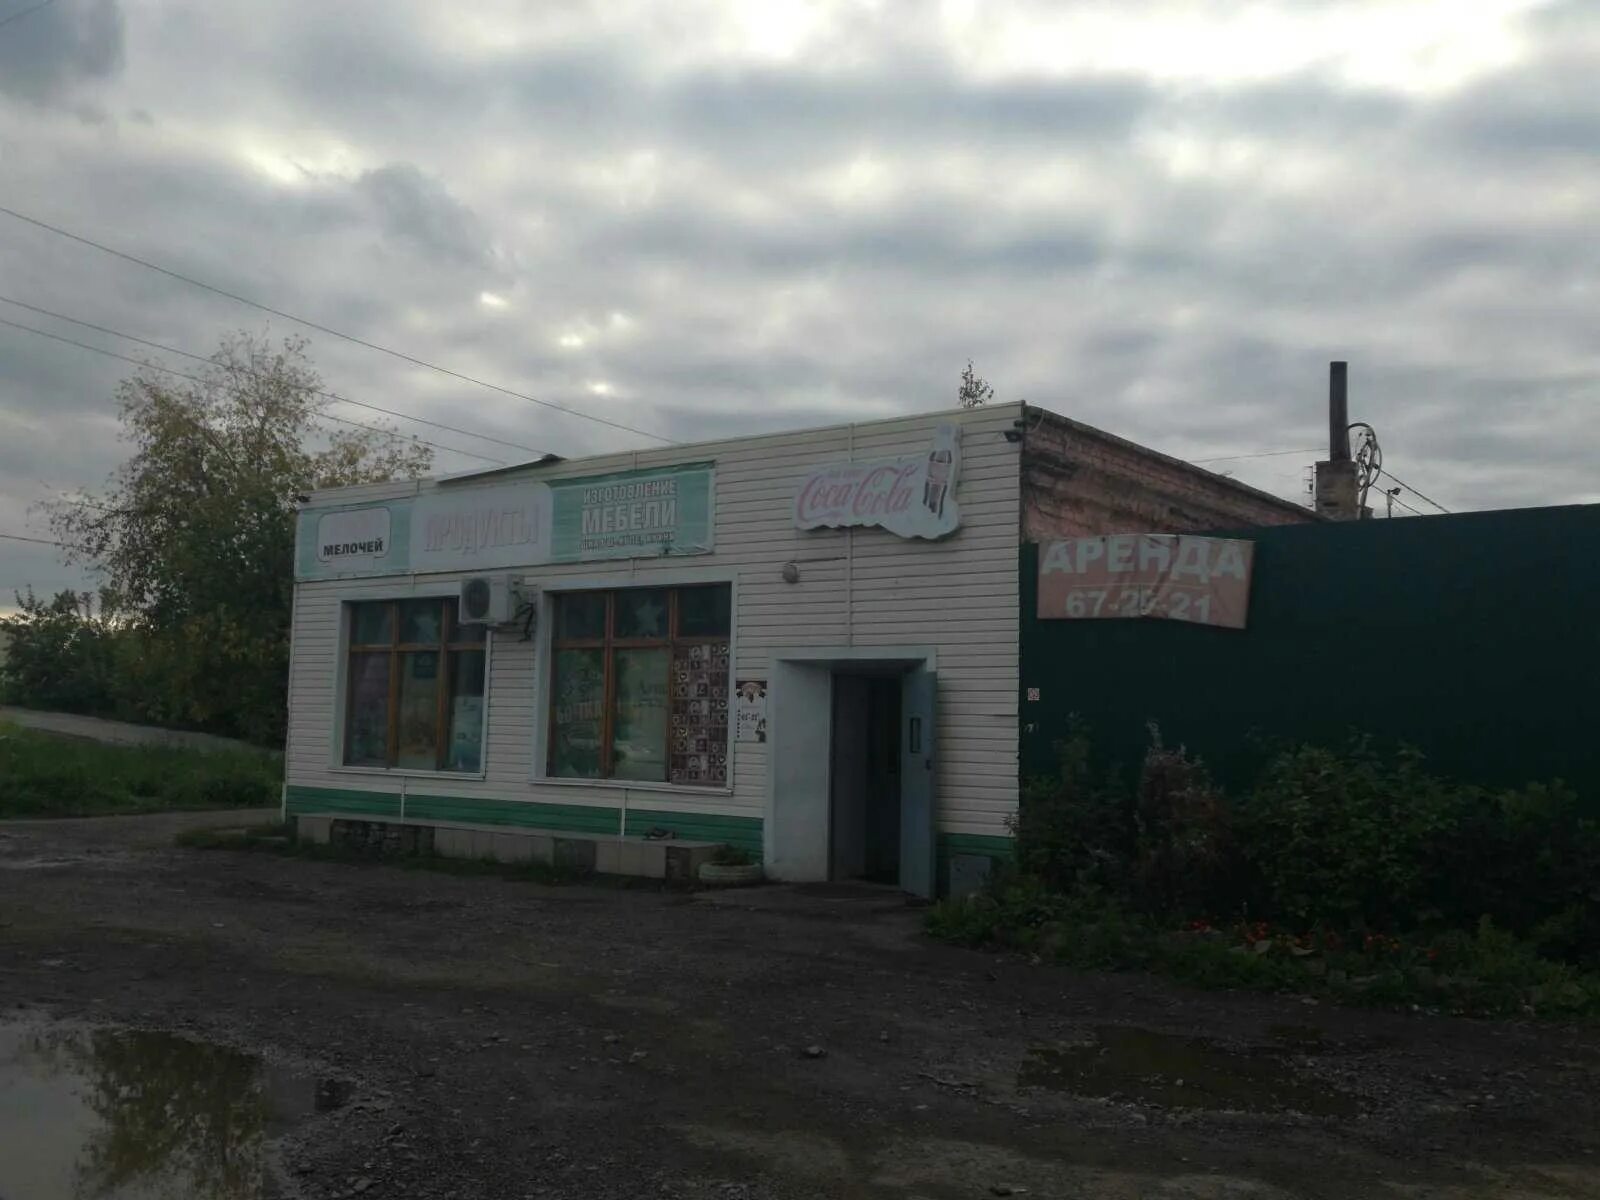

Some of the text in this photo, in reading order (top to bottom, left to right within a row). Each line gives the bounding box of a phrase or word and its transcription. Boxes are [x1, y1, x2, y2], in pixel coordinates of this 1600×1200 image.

[583, 480, 677, 504] ИЗГОТОВЛЕНИЕ
[424, 504, 539, 556] ПРОДУКТЫ
[581, 501, 676, 534] МЕБЕЛИ
[323, 537, 383, 556] МЕЛОЧЕЙ
[1040, 535, 1246, 583] АРЕНДА
